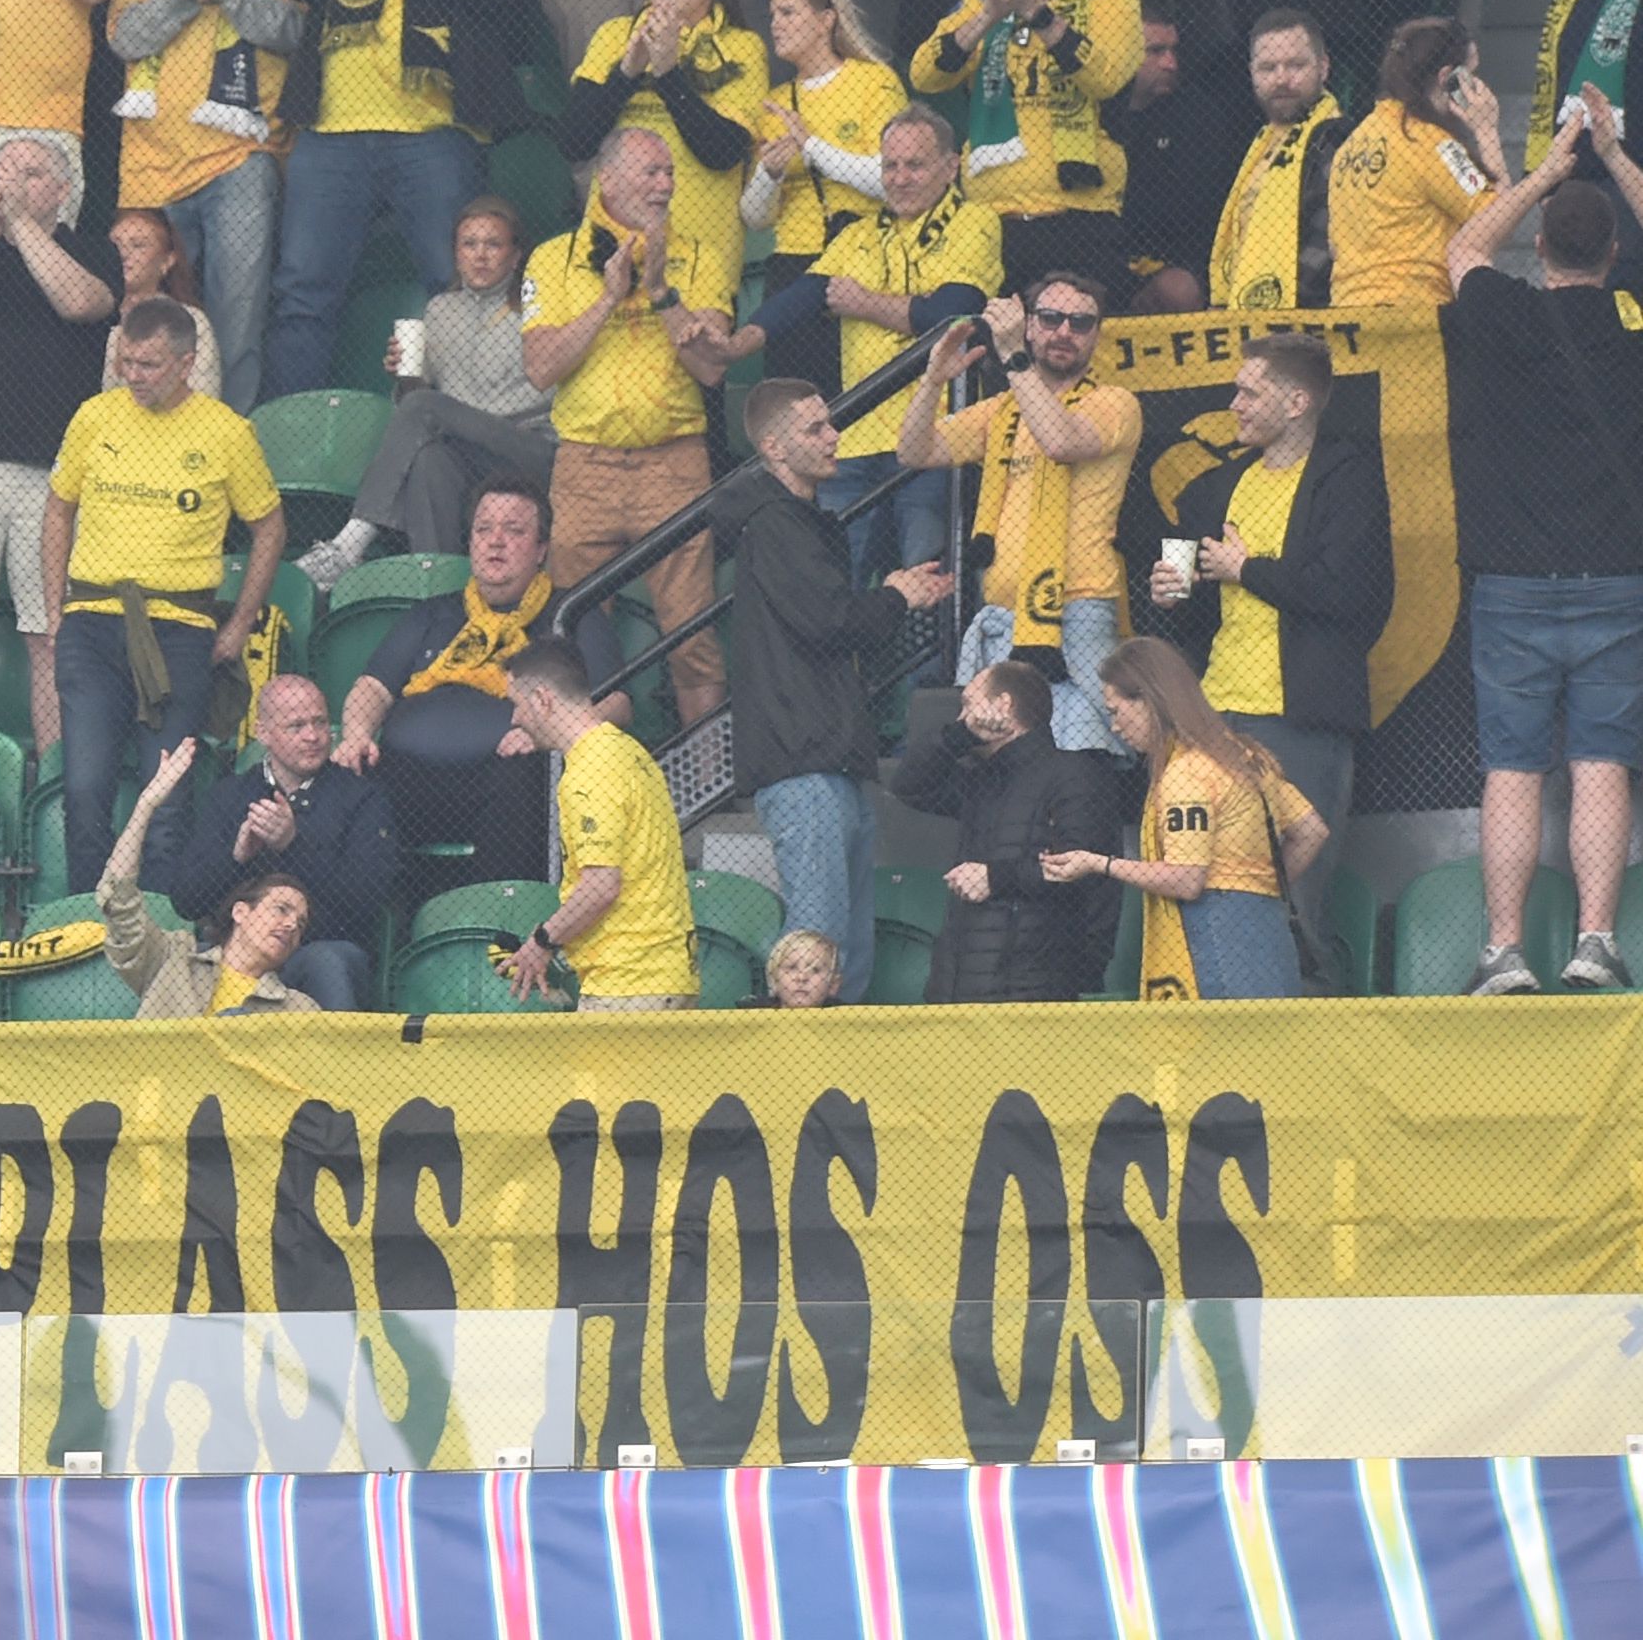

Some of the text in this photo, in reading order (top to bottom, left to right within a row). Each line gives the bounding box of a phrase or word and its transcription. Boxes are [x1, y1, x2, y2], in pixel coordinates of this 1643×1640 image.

[1166, 806, 1209, 833] an
[544, 1086, 878, 1472] HOS
[951, 1087, 1272, 1465] OSS
